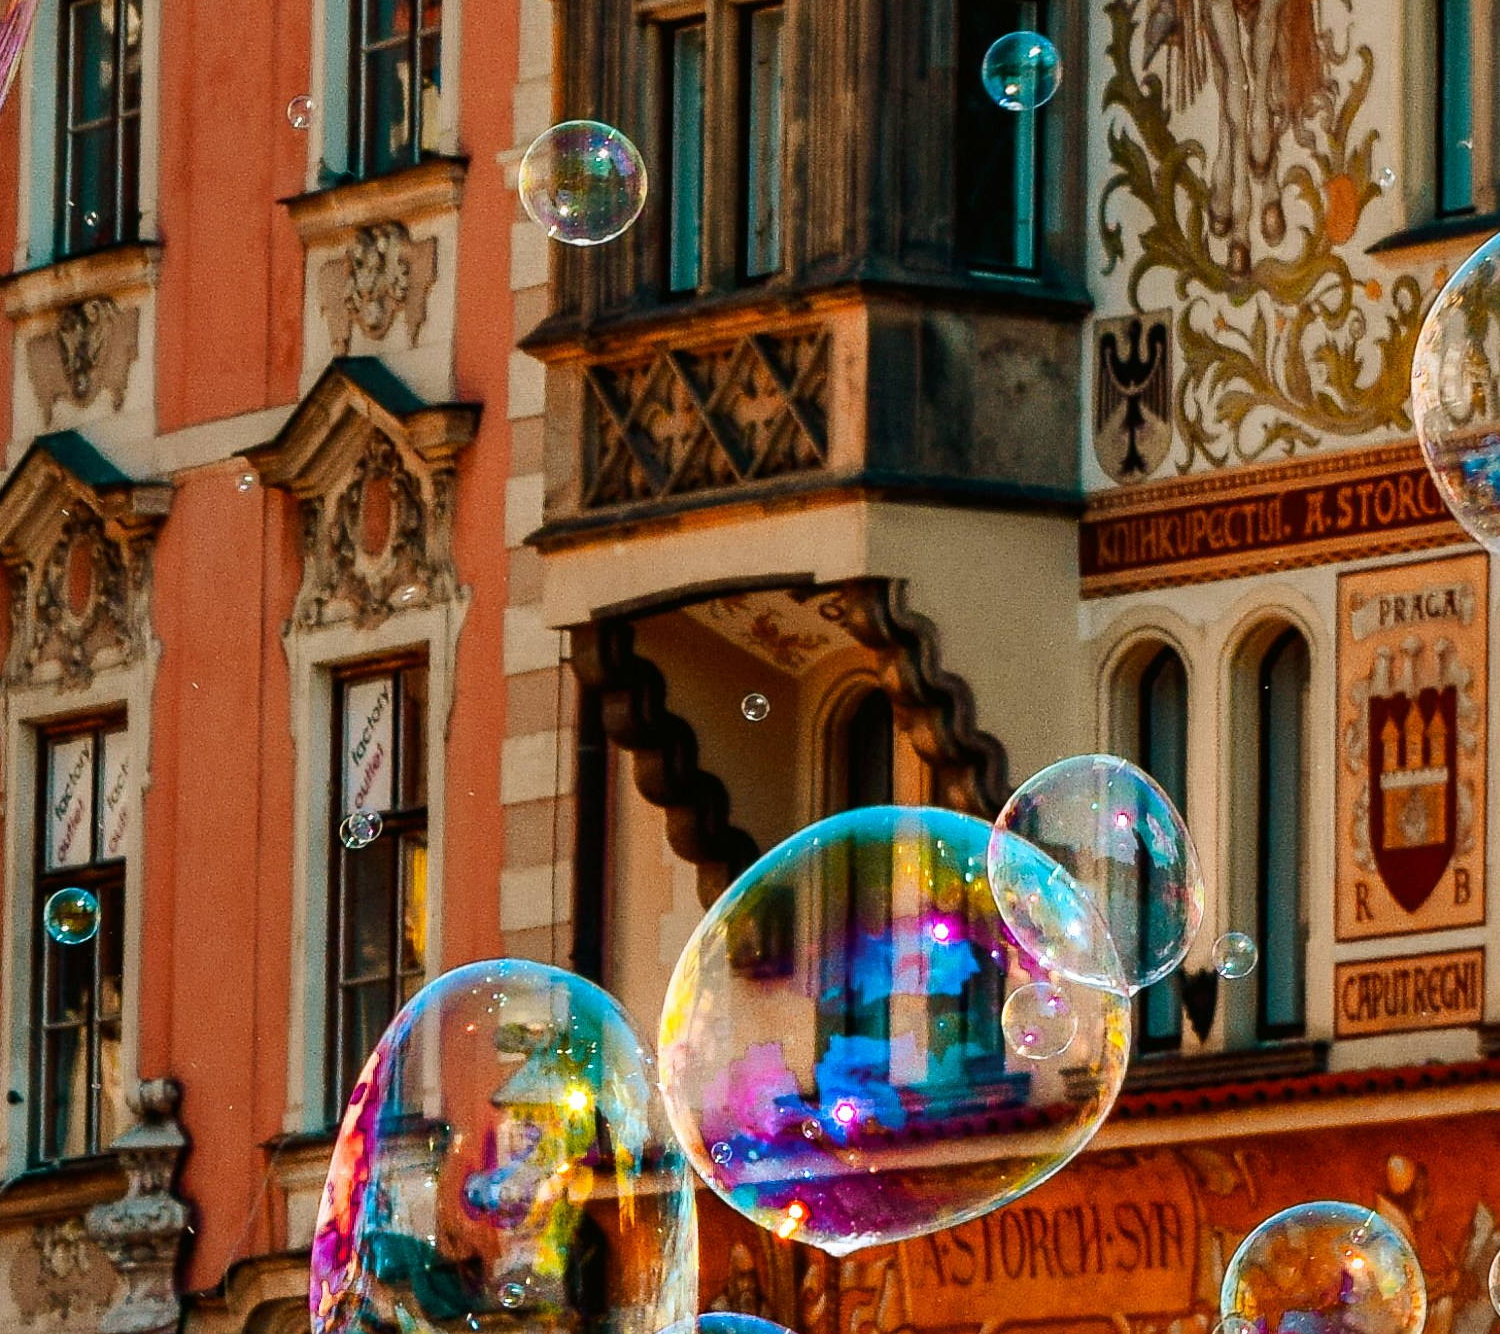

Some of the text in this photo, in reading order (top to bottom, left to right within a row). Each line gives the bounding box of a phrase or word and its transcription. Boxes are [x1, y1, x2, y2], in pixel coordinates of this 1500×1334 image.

[1379, 588, 1460, 626] PRAGA
[1355, 868, 1471, 921] R B
